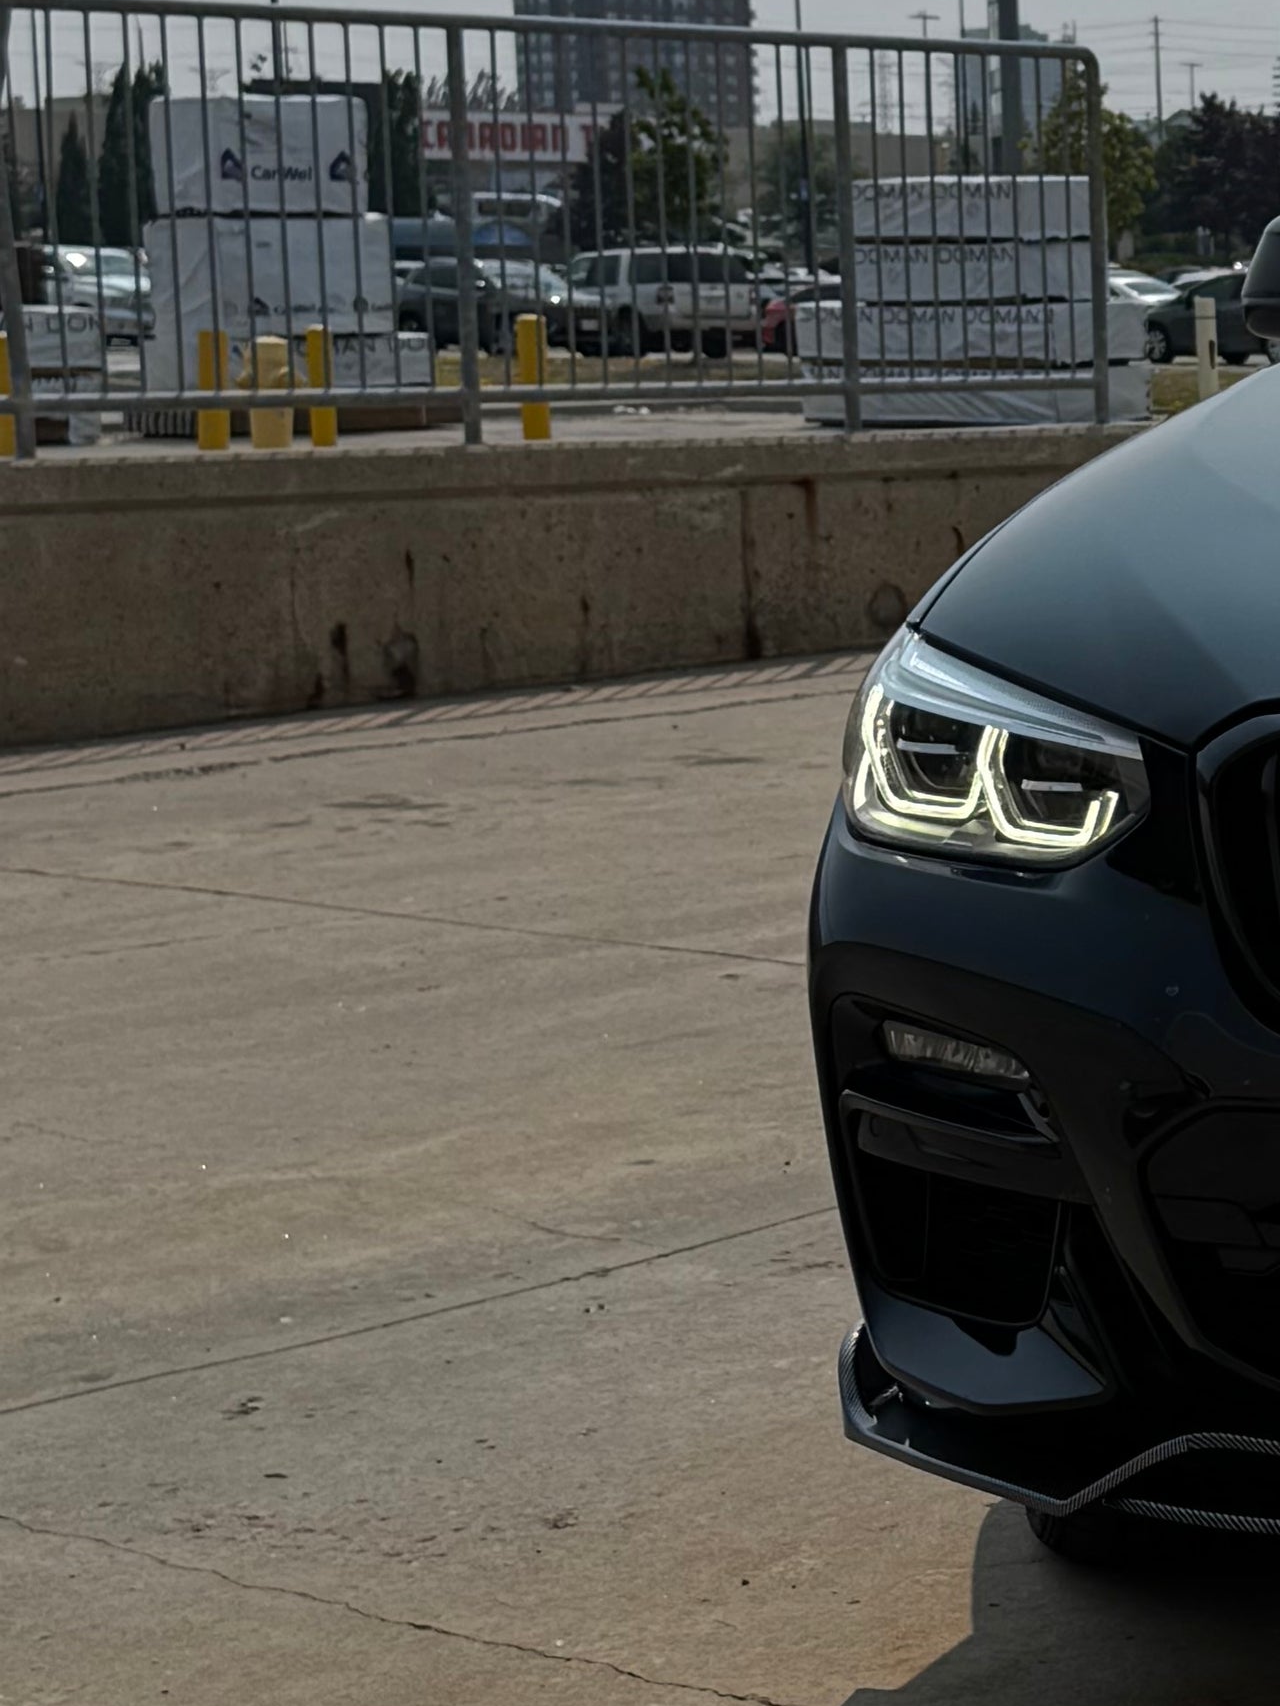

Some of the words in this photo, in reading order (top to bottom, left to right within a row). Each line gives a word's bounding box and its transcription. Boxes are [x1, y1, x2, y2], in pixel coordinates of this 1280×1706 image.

[853, 183, 928, 201] DOMAN
[935, 182, 1012, 200] DOMAN
[854, 247, 930, 265] DOMAN
[937, 246, 1015, 264] DOMAN
[799, 307, 875, 325] DOMN
